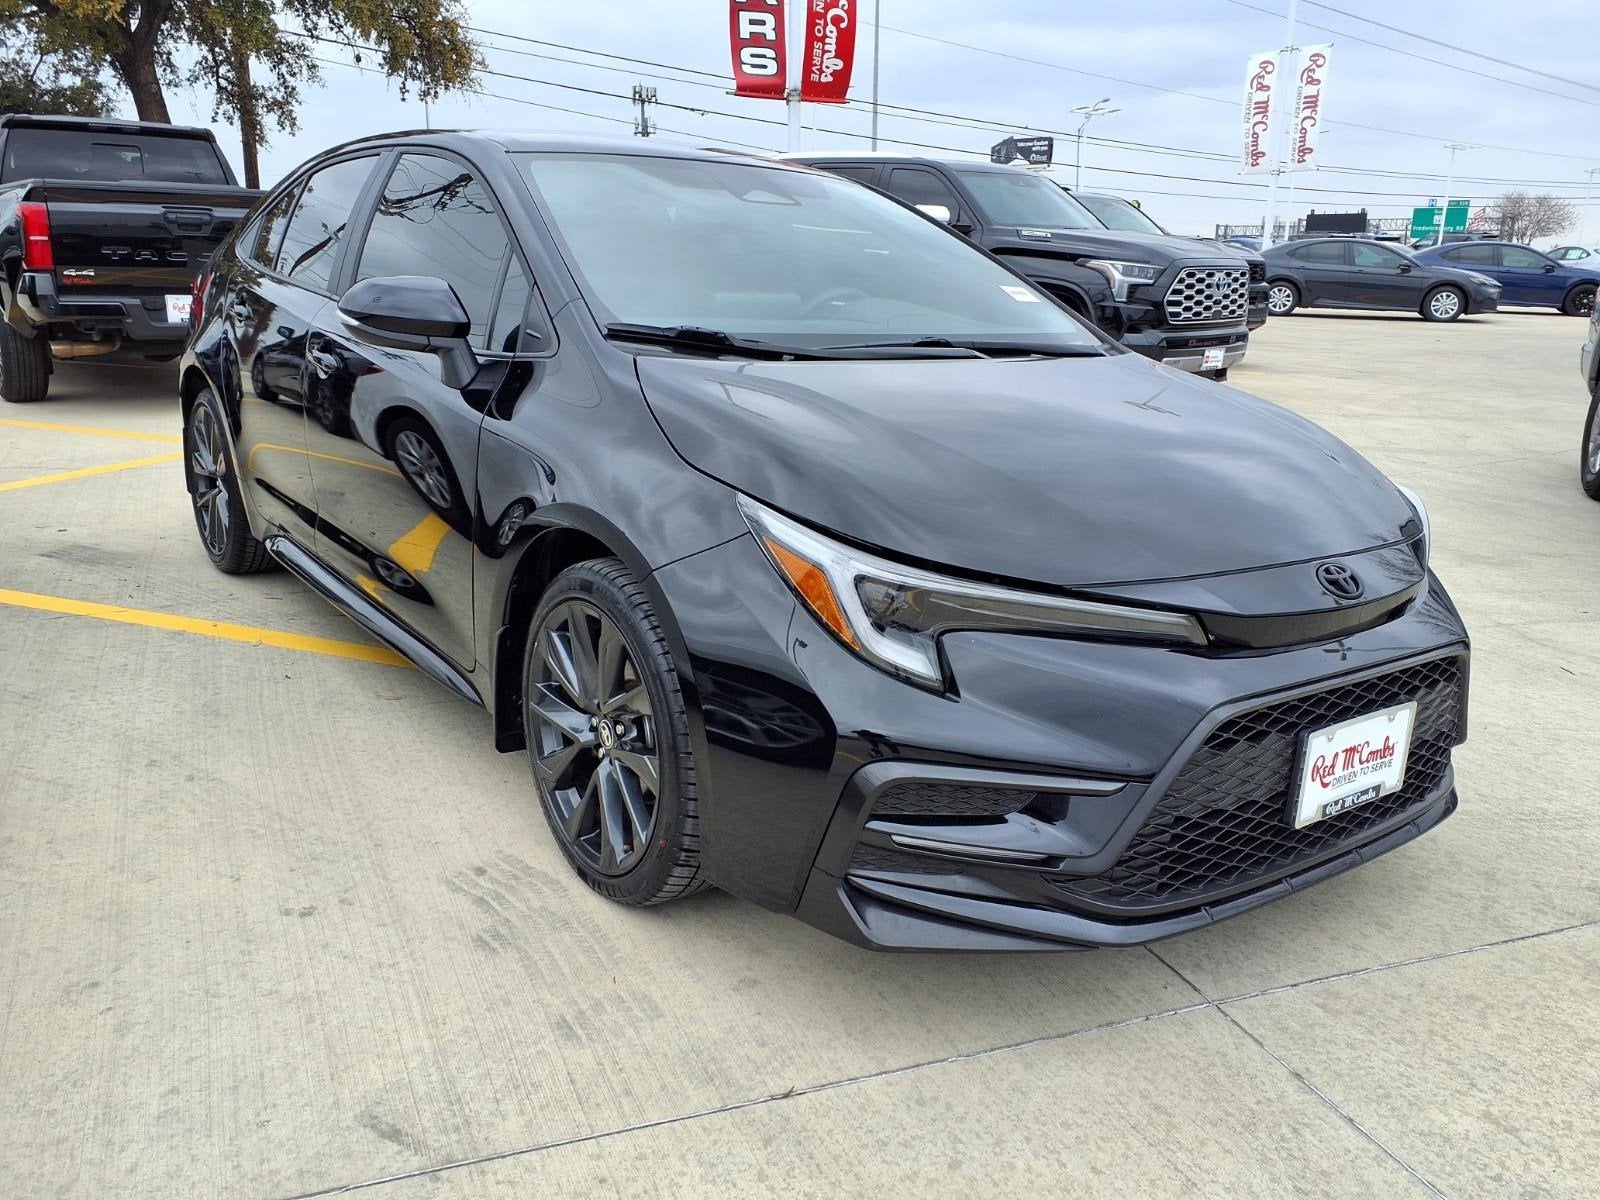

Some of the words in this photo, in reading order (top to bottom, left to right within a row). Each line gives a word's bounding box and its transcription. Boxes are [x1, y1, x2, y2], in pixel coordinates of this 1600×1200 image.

[736, 0, 779, 76] RS
[815, 19, 825, 37] TO
[811, 41, 823, 82] SERVE
[1249, 60, 1275, 93] Red
[1300, 52, 1327, 86] Red
[1243, 92, 1254, 124] DRIVEN
[1294, 86, 1304, 119] DRIVEN
[1250, 94, 1270, 167] McCombs
[1296, 88, 1321, 164] McCombs
[1311, 752, 1339, 789] Red
[1341, 735, 1396, 772] McCombs
[1331, 769, 1359, 788] DRIVEN
[1359, 766, 1370, 777] TO
[1370, 758, 1393, 774] SERVE
[1326, 800, 1342, 815] Red
[1344, 788, 1376, 808] McCombs
